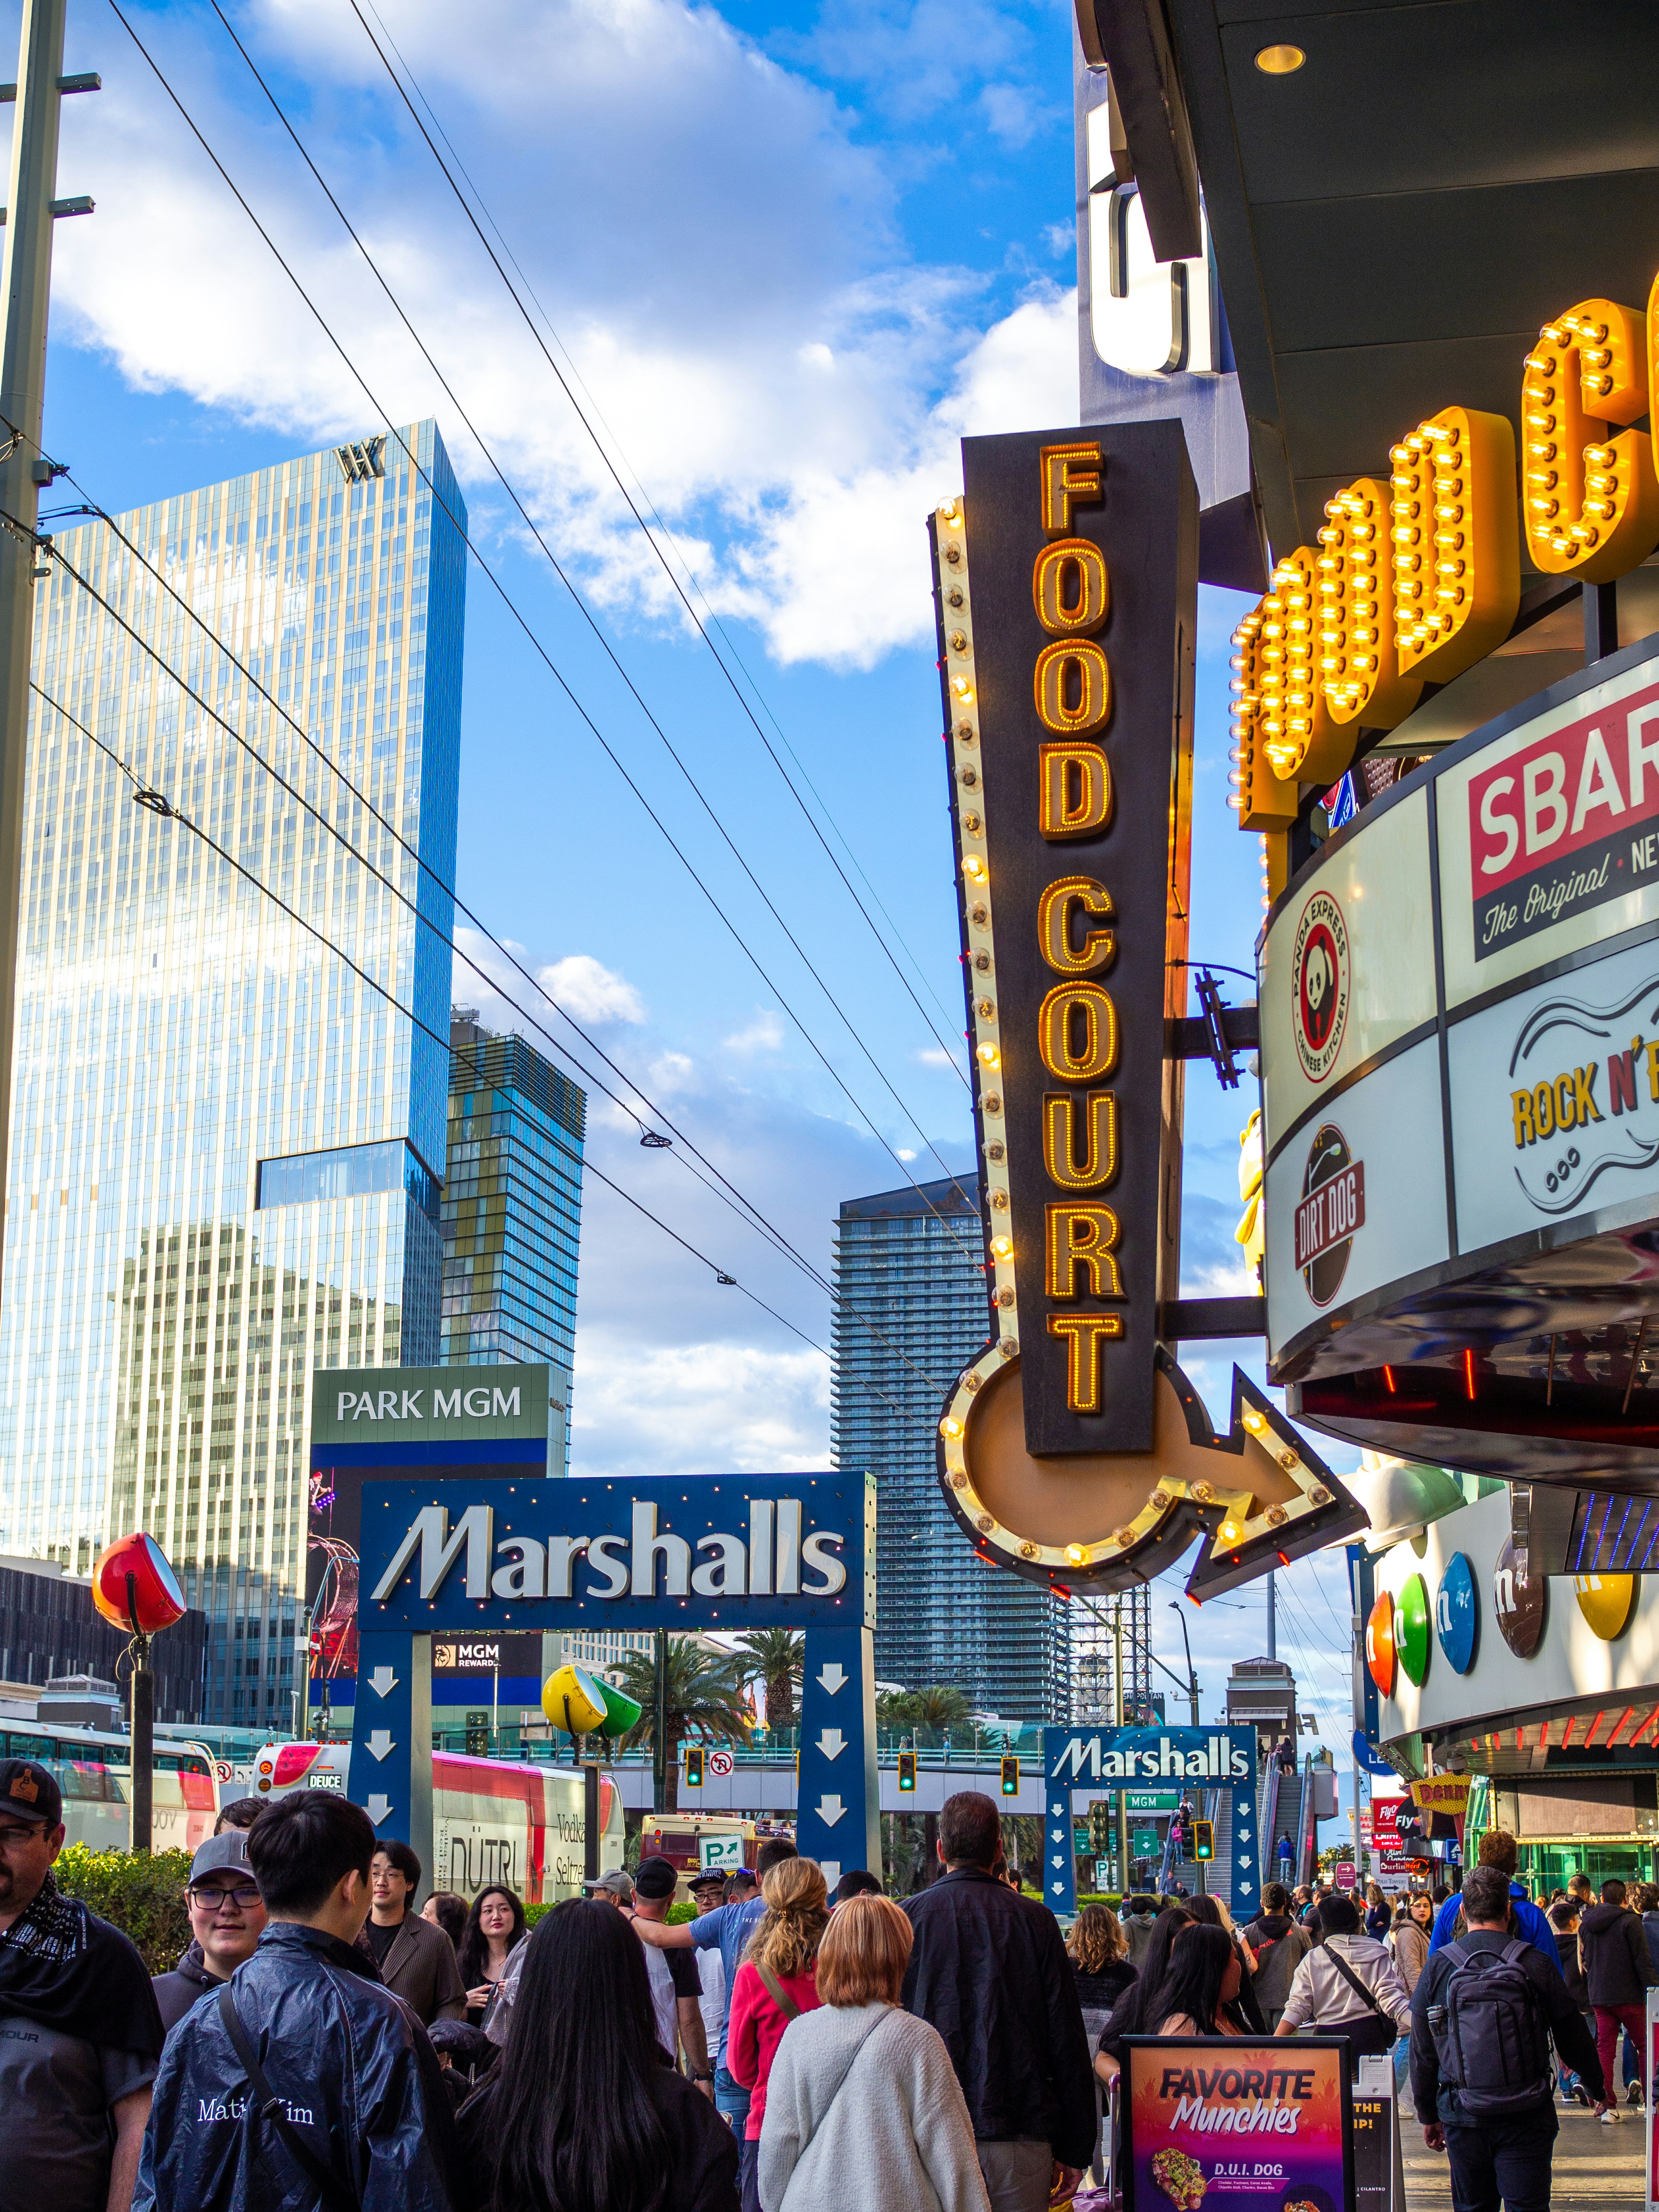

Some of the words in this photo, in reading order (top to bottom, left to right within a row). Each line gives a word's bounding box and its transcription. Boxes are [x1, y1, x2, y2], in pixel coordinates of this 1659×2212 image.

[1033, 442, 1113, 841] FOOD
[1483, 905, 1517, 945] The
[1524, 853, 1610, 924] Original
[1632, 830, 1659, 874] NE
[1294, 917, 1310, 998] PANDA
[1311, 900, 1346, 957] EXPRESS
[1298, 1030, 1321, 1072] CHINESE
[1323, 993, 1346, 1067] KITCHEN
[1510, 1062, 1606, 1149] ROCK
[1038, 876, 1128, 1414] COURT
[1299, 1192, 1324, 1261] DIRT
[1328, 1172, 1356, 1239] DOG
[337, 1389, 424, 1421] PARK
[433, 1386, 521, 1419] MGM
[371, 1499, 846, 1600] Marshalls
[459, 1645, 499, 1658] MGM
[1051, 1736, 1249, 1777] Marshalls
[310, 1775, 341, 1788] DEUCE
[1131, 1797, 1156, 1807] MGM
[1380, 1805, 1398, 1820] FlyO
[1159, 2068, 1315, 2100] FAVORITE
[1169, 2095, 1301, 2135] Munchies
[1354, 2103, 1381, 2113] THE
[1354, 2119, 1372, 2129] IP!
[1214, 2163, 1250, 2175] D.U.I.
[1254, 2164, 1283, 2176] DOG
